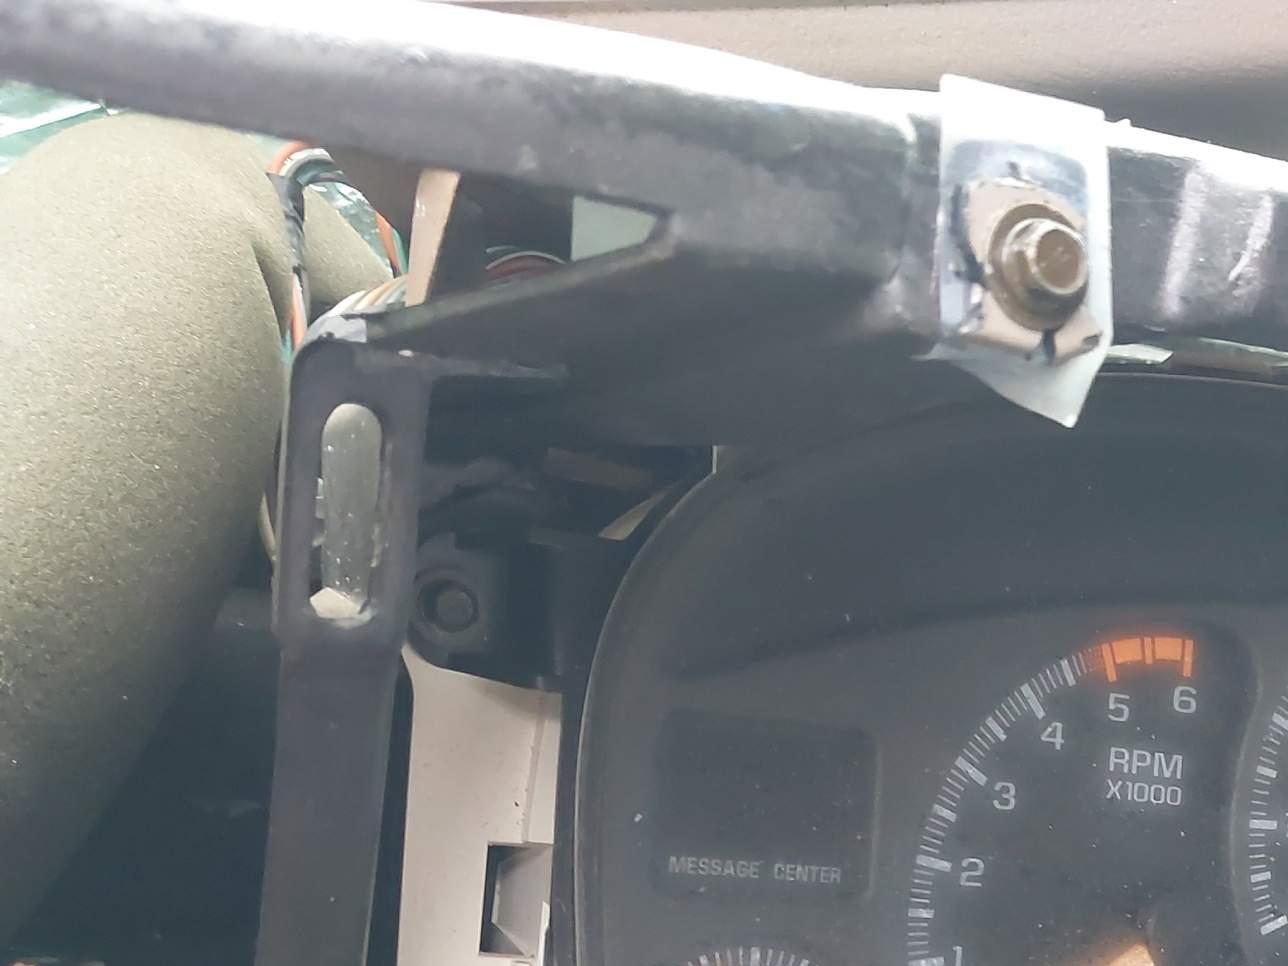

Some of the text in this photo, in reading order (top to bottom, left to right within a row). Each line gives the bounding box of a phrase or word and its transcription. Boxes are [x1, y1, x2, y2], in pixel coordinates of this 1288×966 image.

[1107, 692, 1131, 722] 5
[1172, 686, 1198, 714] 6
[1041, 721, 1064, 750] 4
[1108, 747, 1184, 780] RPM
[992, 782, 1016, 811] 3
[1105, 779, 1183, 807] X1000
[668, 855, 842, 884] MESSAGE CENTER
[960, 858, 985, 887] 2
